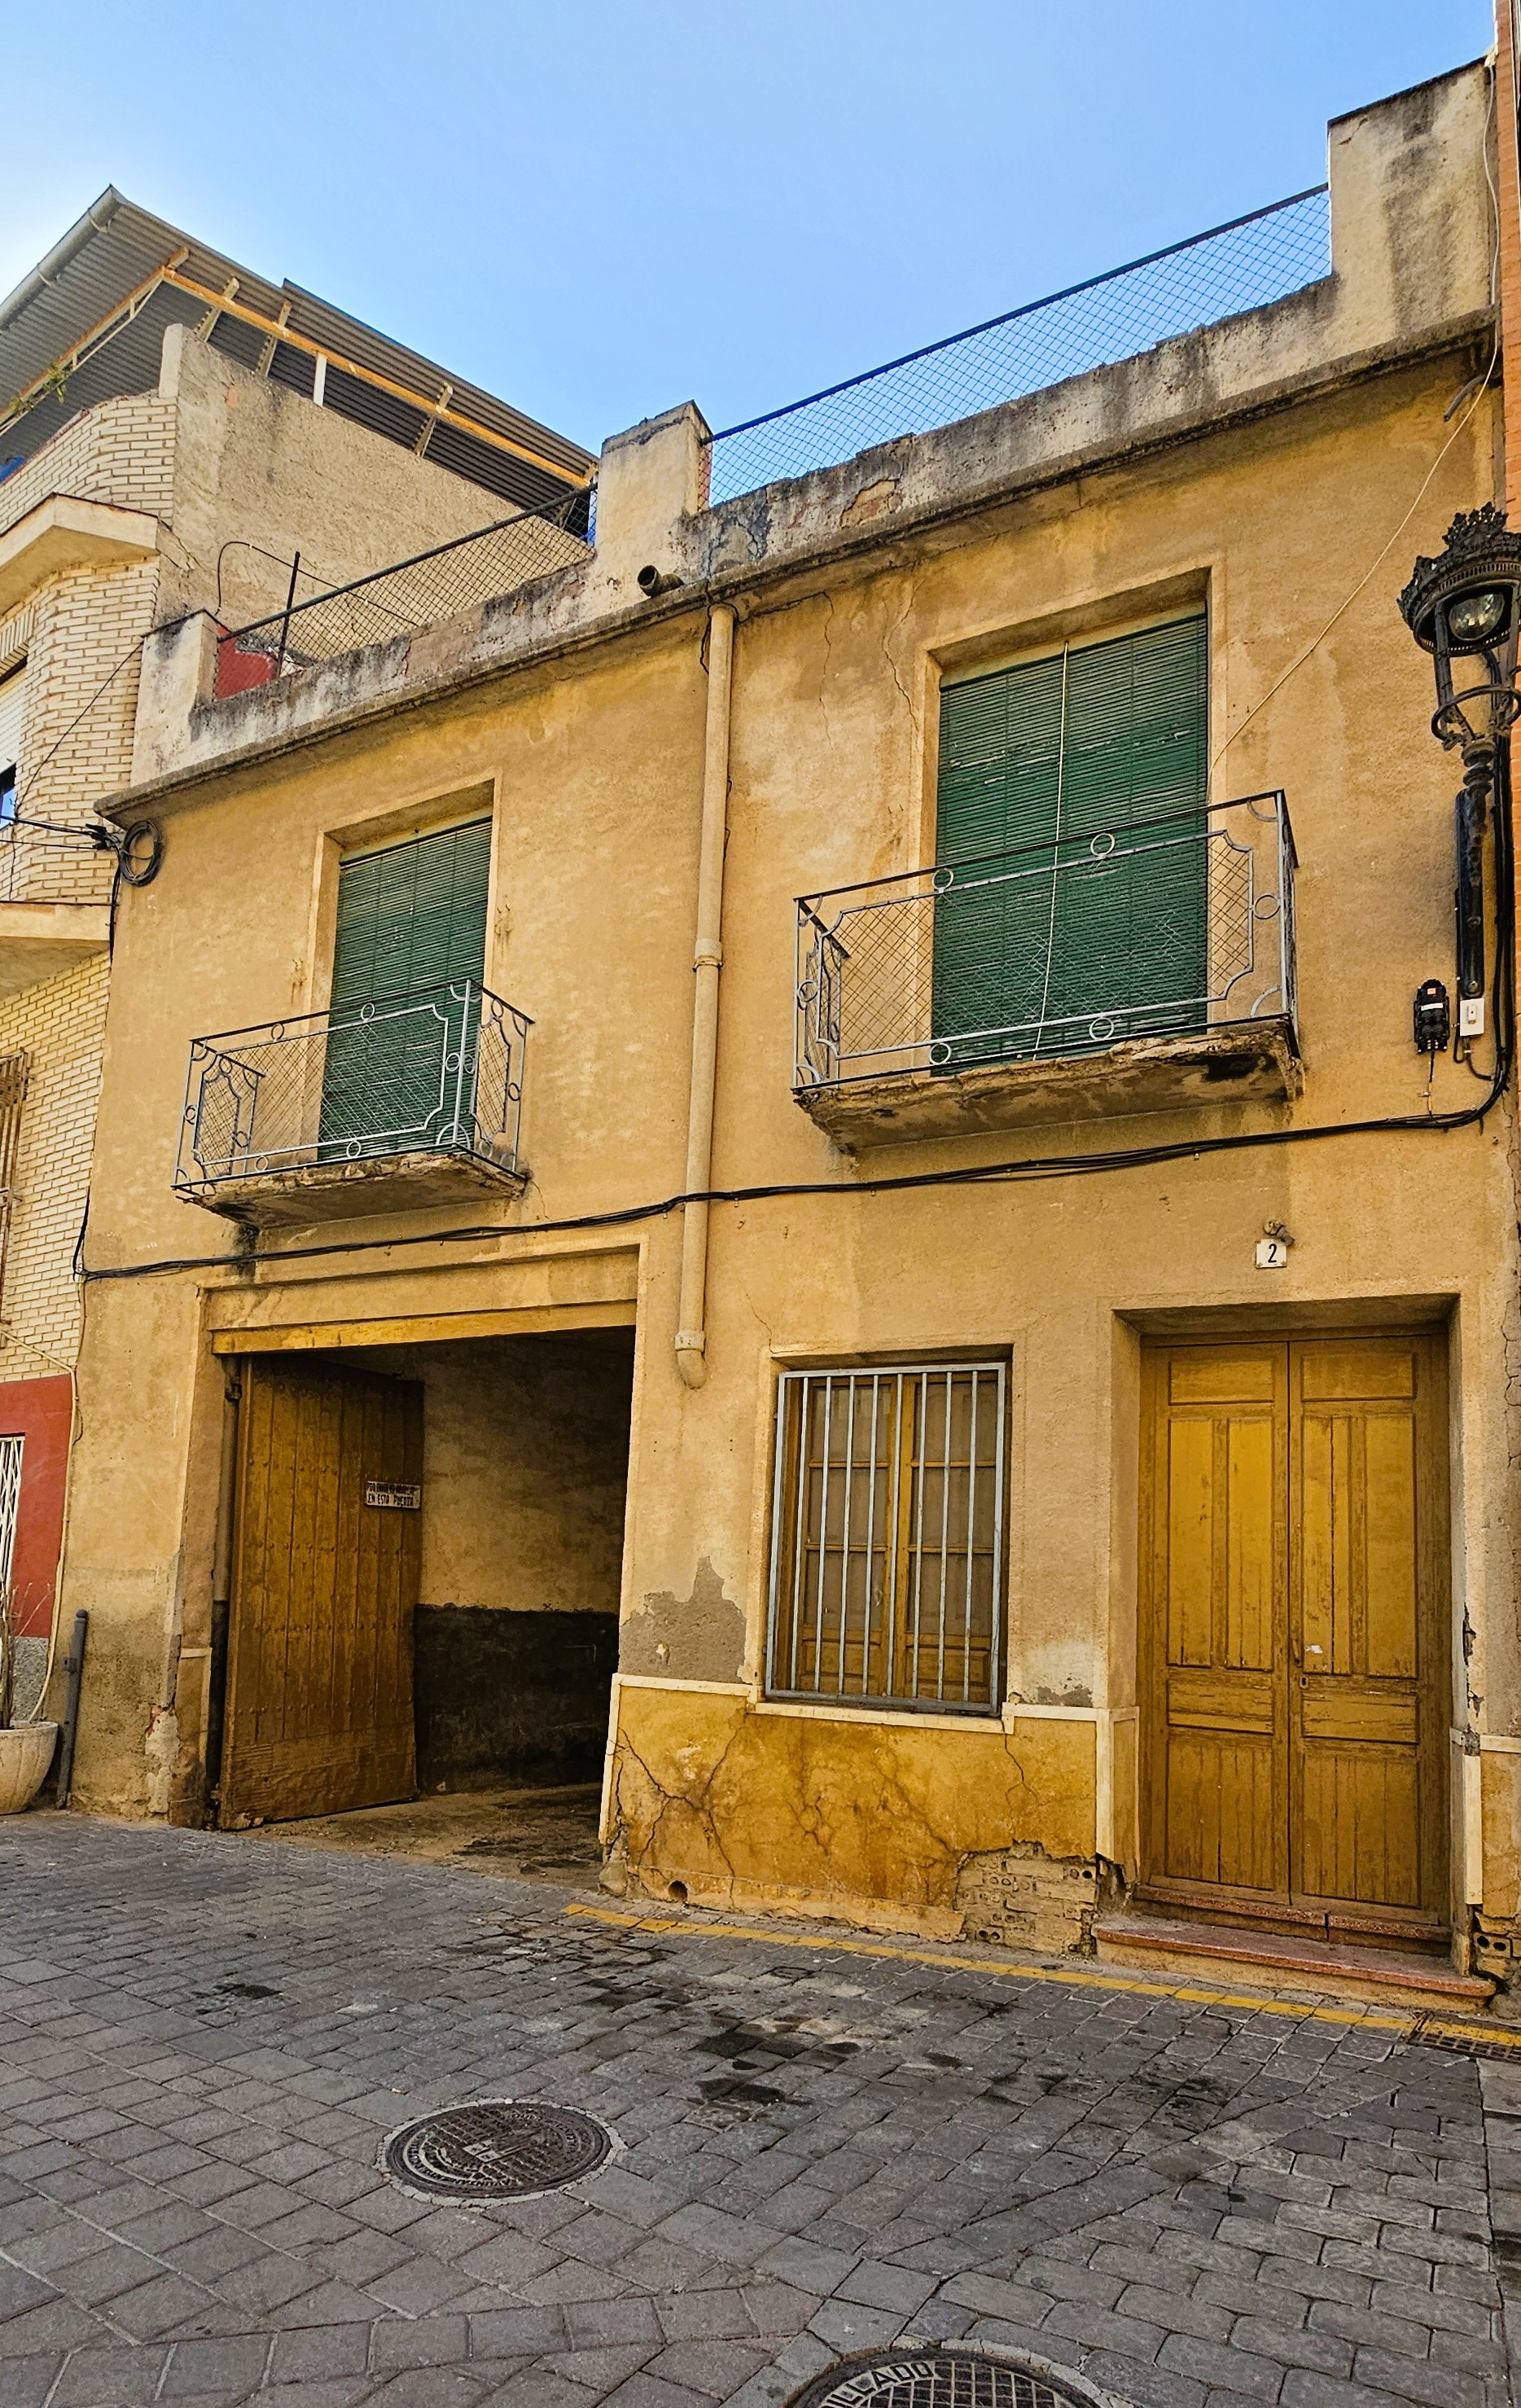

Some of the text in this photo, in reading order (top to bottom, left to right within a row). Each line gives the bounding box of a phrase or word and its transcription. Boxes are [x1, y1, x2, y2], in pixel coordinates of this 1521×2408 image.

[1268, 1243, 1277, 1263] 2
[368, 1493, 414, 1507] EN ESTA PUERTA
[821, 2362, 934, 2408] ILLADO
